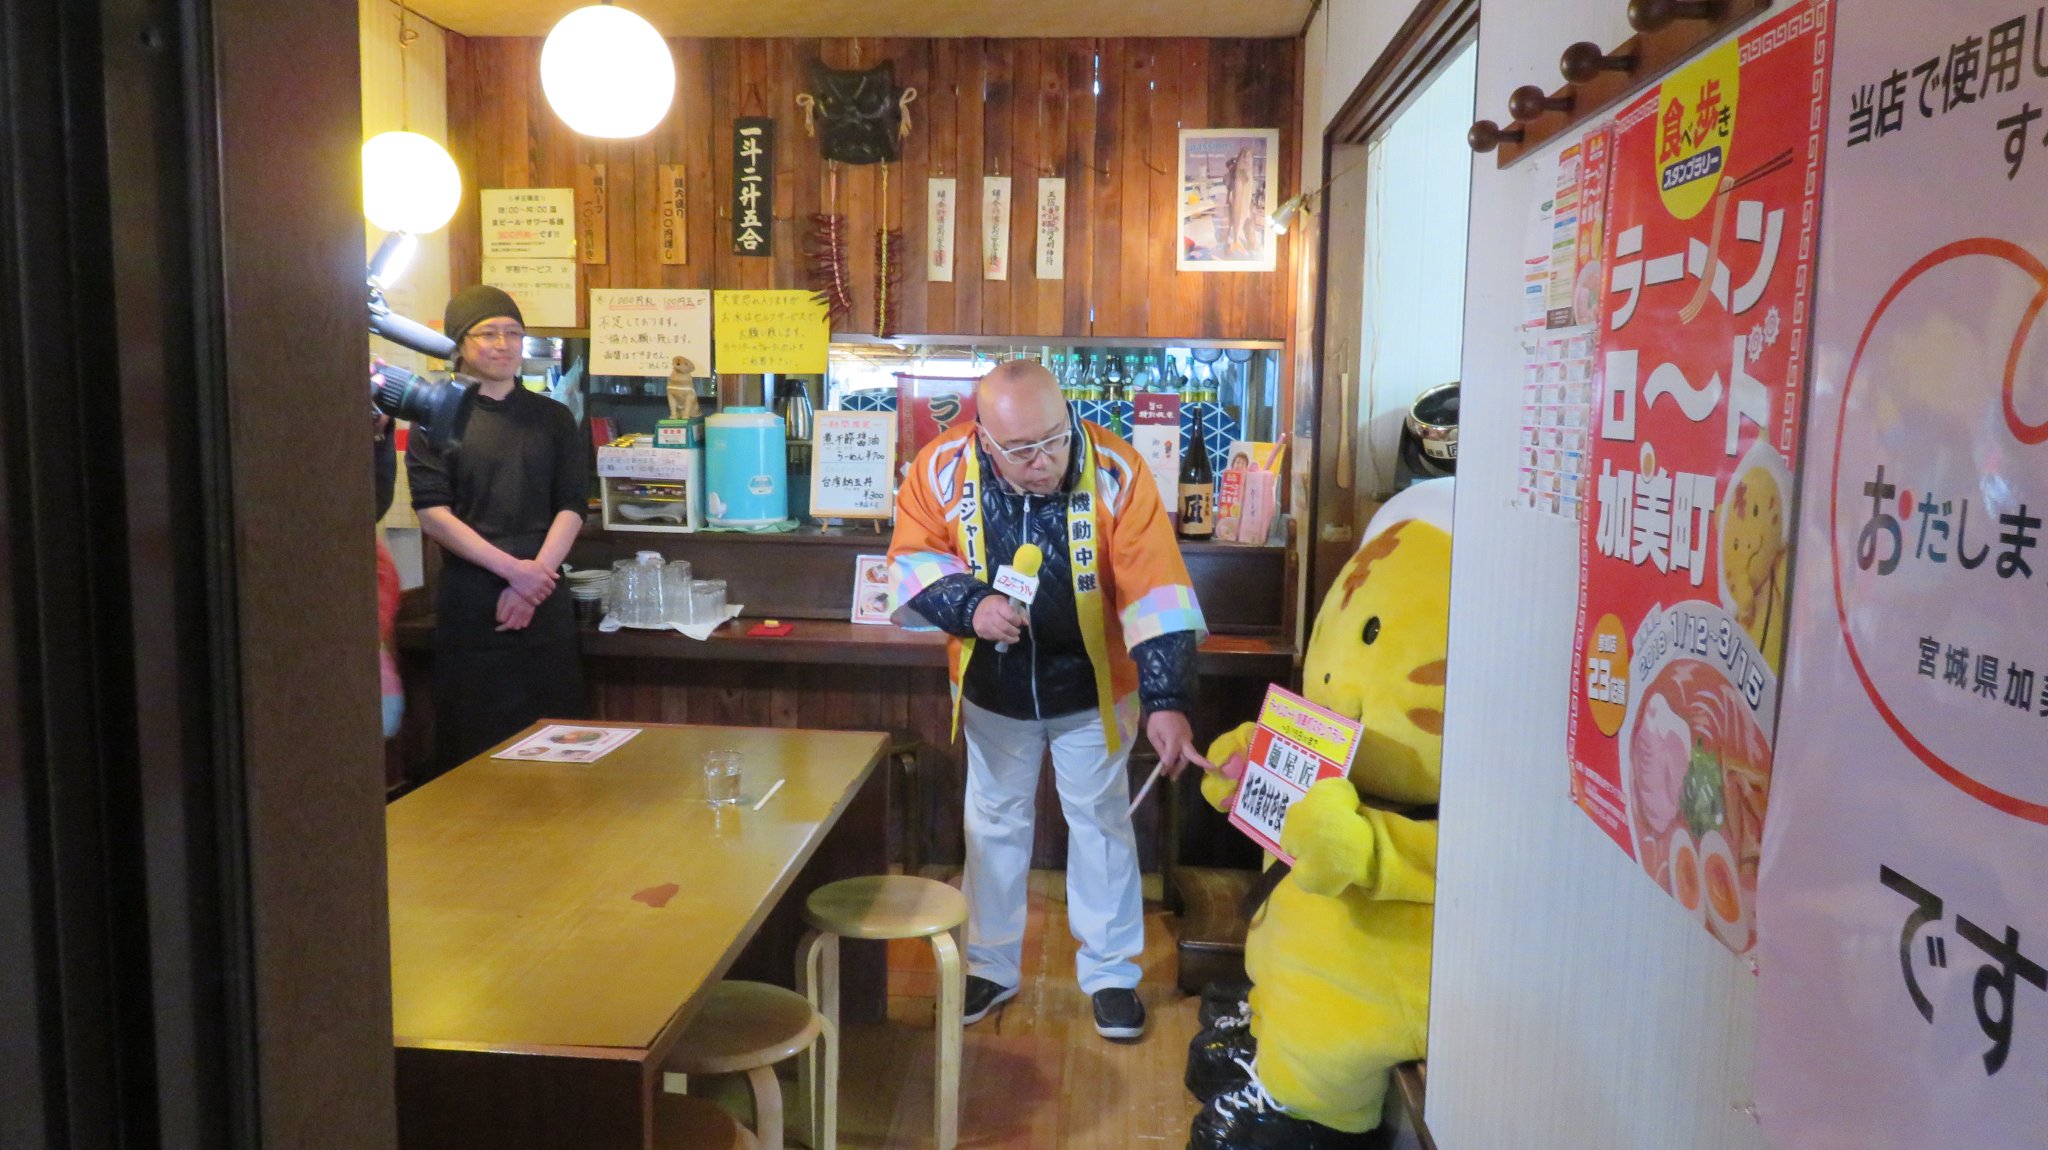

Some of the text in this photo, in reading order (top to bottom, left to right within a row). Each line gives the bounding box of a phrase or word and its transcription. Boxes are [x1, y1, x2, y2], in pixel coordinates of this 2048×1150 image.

[1659, 79, 1731, 164] 食べ歩き
[1663, 152, 1719, 189] スタンプラリー
[1997, 102, 2048, 181] す
[736, 127, 764, 250] 一斗二升五合
[1610, 200, 1785, 331] ラーメン
[1070, 492, 1097, 592] 機動中継
[1596, 459, 1717, 586] 加美町
[1639, 630, 1667, 682] 2018
[1879, 863, 2048, 1077] です
